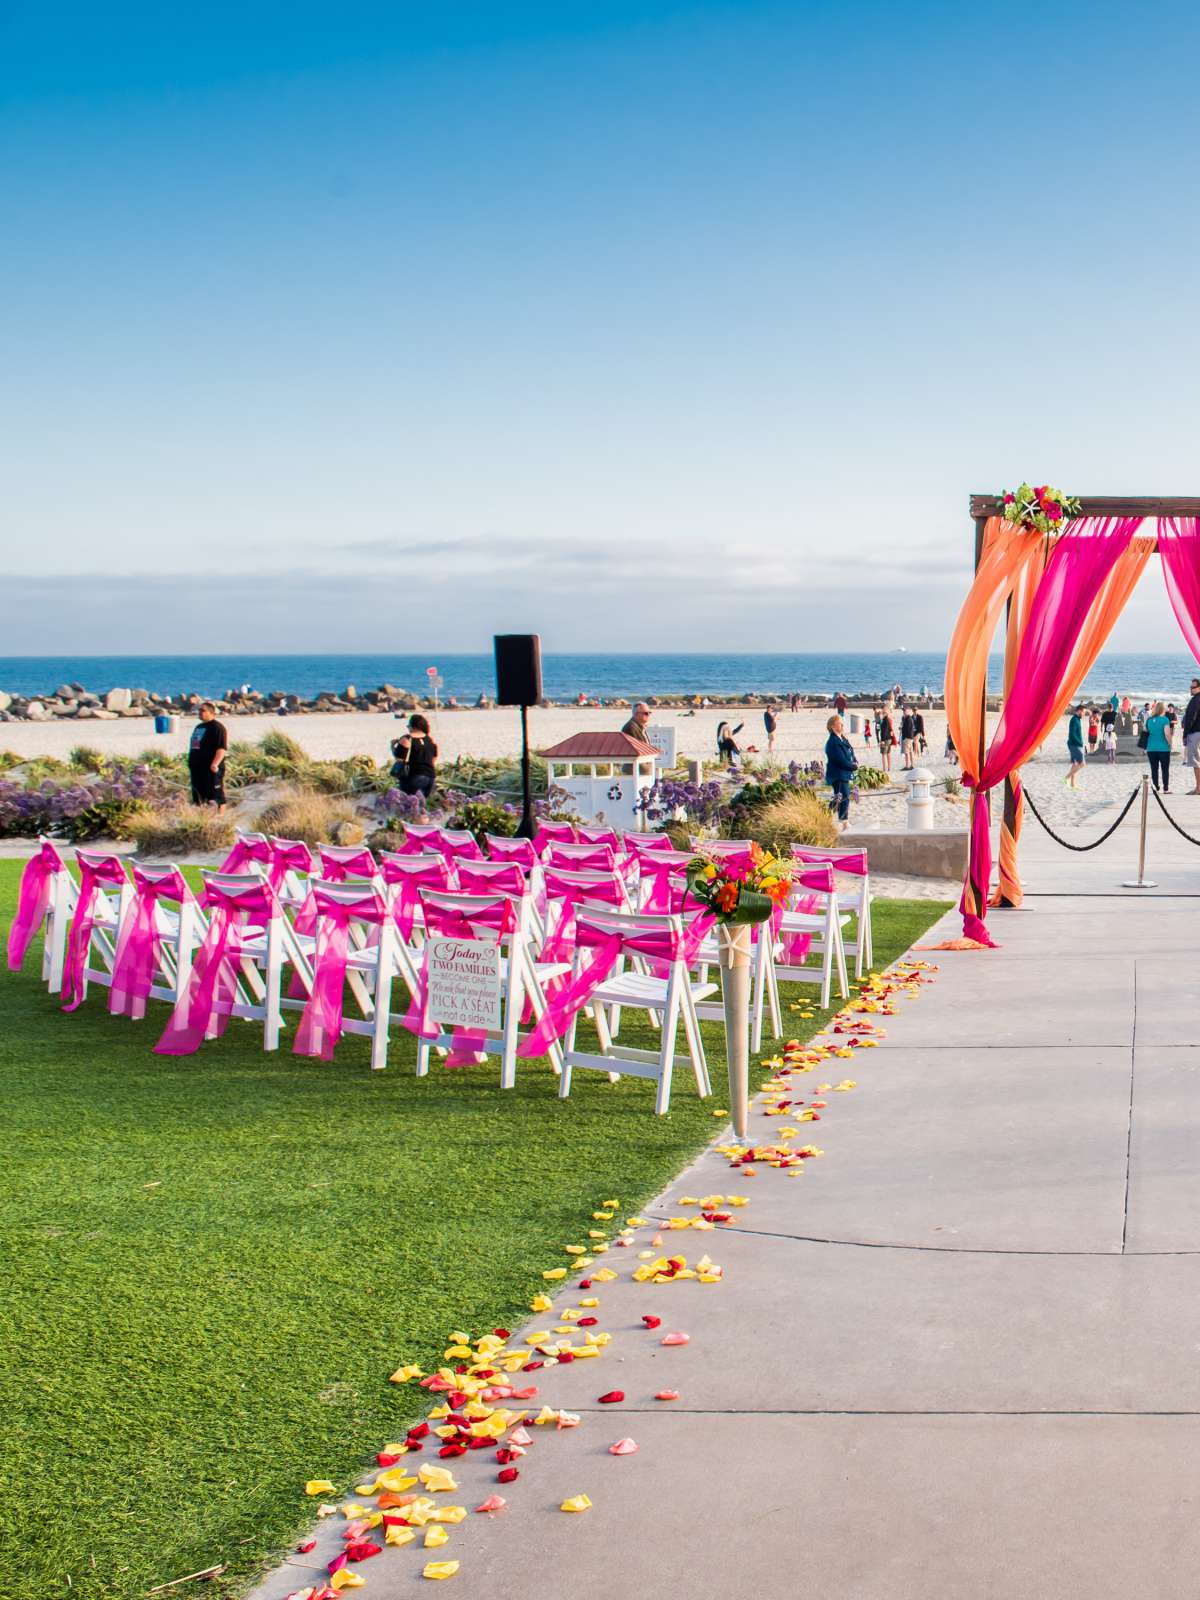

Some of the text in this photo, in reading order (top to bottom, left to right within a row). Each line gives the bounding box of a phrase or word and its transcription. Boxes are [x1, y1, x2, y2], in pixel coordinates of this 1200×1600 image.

[432, 960, 496, 976] TWO FAMILIES
[440, 973, 487, 985] BECOME ONE
[432, 994, 496, 1013] PICK A SEAT
[443, 1011, 485, 1024] not a side
